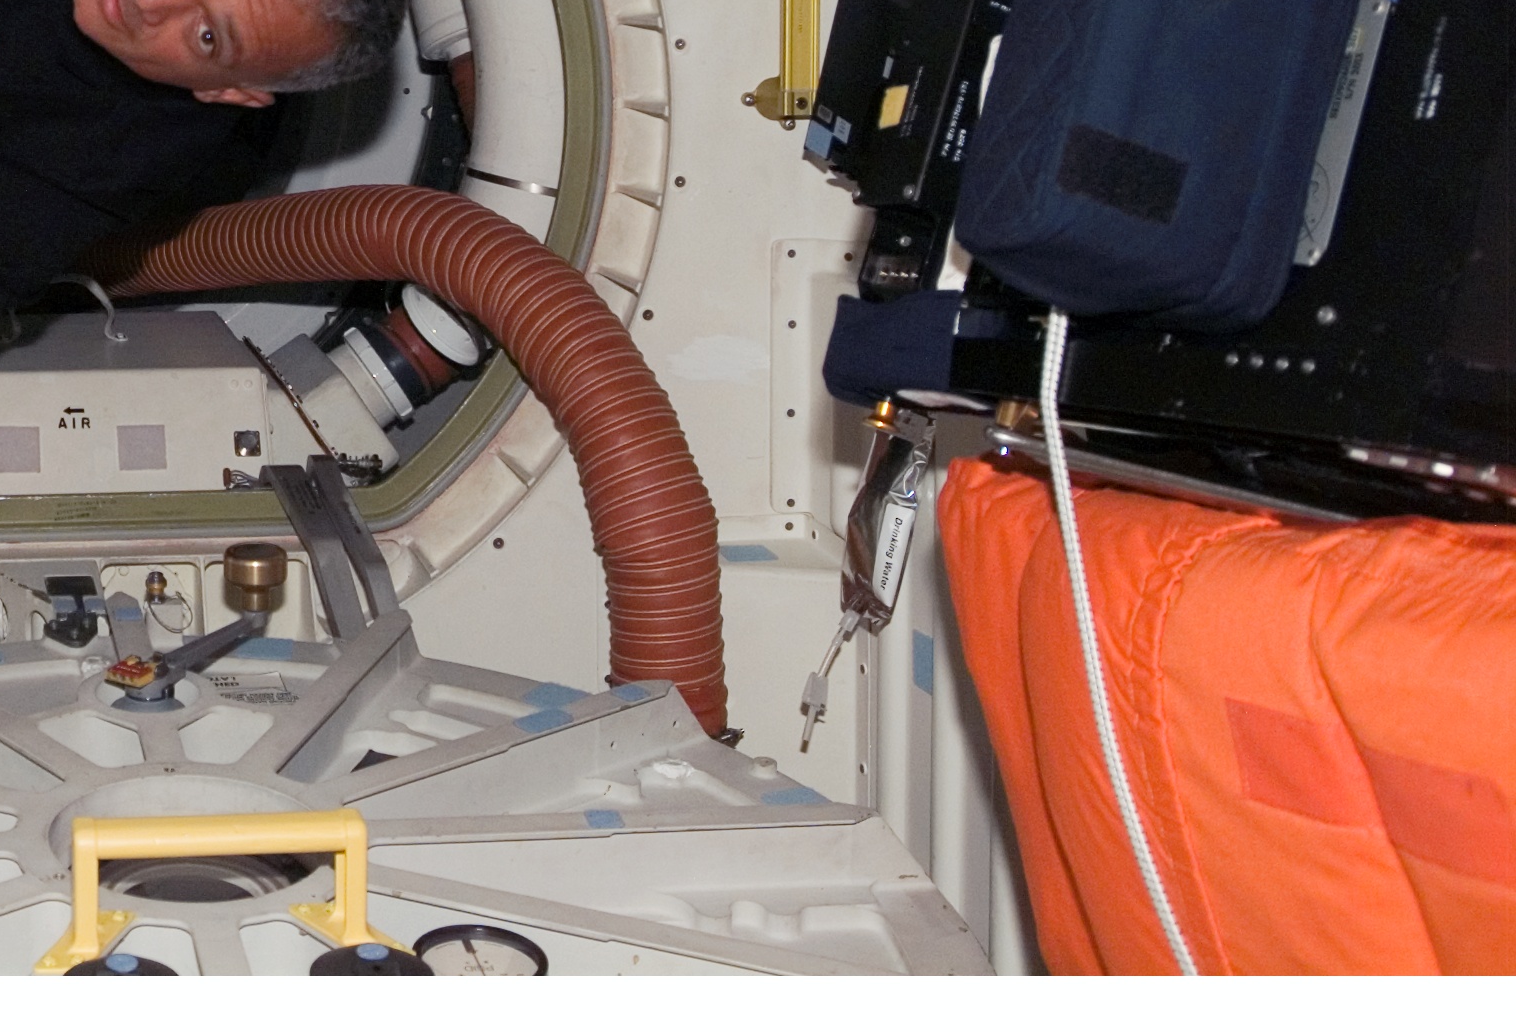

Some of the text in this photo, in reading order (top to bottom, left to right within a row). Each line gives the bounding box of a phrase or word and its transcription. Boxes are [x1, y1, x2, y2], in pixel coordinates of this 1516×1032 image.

[57, 416, 92, 430] AIR
[880, 517, 904, 591] Drinking Water
